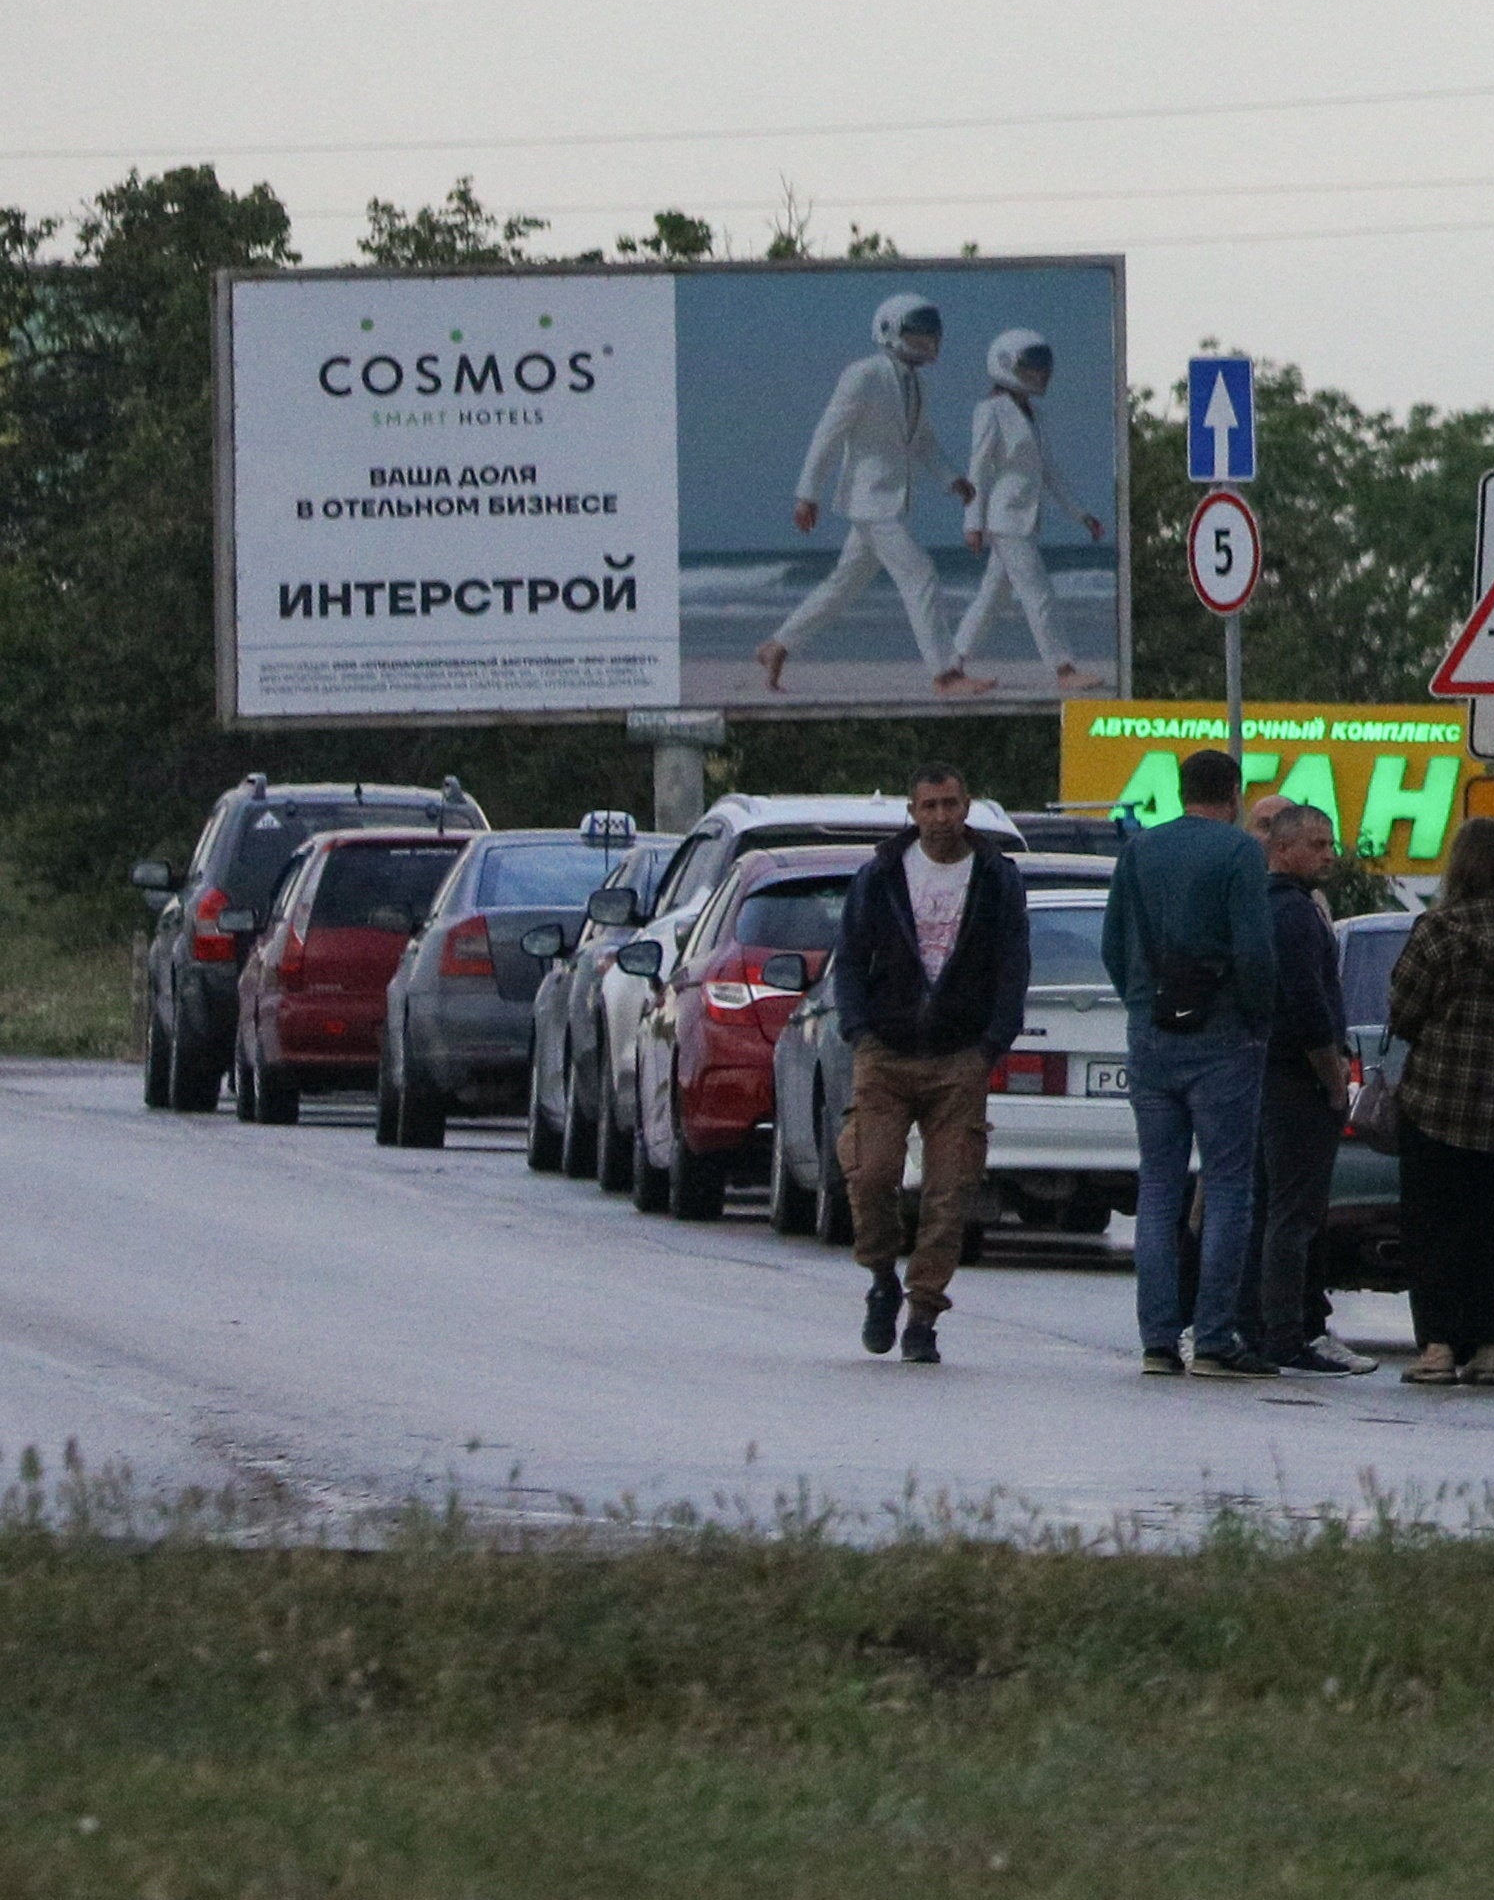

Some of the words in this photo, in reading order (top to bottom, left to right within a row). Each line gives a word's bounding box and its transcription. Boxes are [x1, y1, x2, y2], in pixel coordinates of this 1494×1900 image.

[319, 351, 596, 397] COSMOS
[372, 409, 448, 427] SMART
[459, 408, 544, 426] HOTELS
[369, 466, 451, 488] ВАША
[459, 464, 537, 489] ДОЛЯ
[297, 500, 314, 520] В
[322, 494, 480, 519] ОТЕЛЬНОМ
[488, 493, 618, 517] БИЗНЕСЕ
[1214, 528, 1233, 576] 5
[279, 553, 637, 618] ИНТЕРСТРОЙ
[1090, 716, 1325, 741] АВТОЗАПРАОЧНЫЙ
[1332, 721, 1462, 743] КОМПЛЕКС
